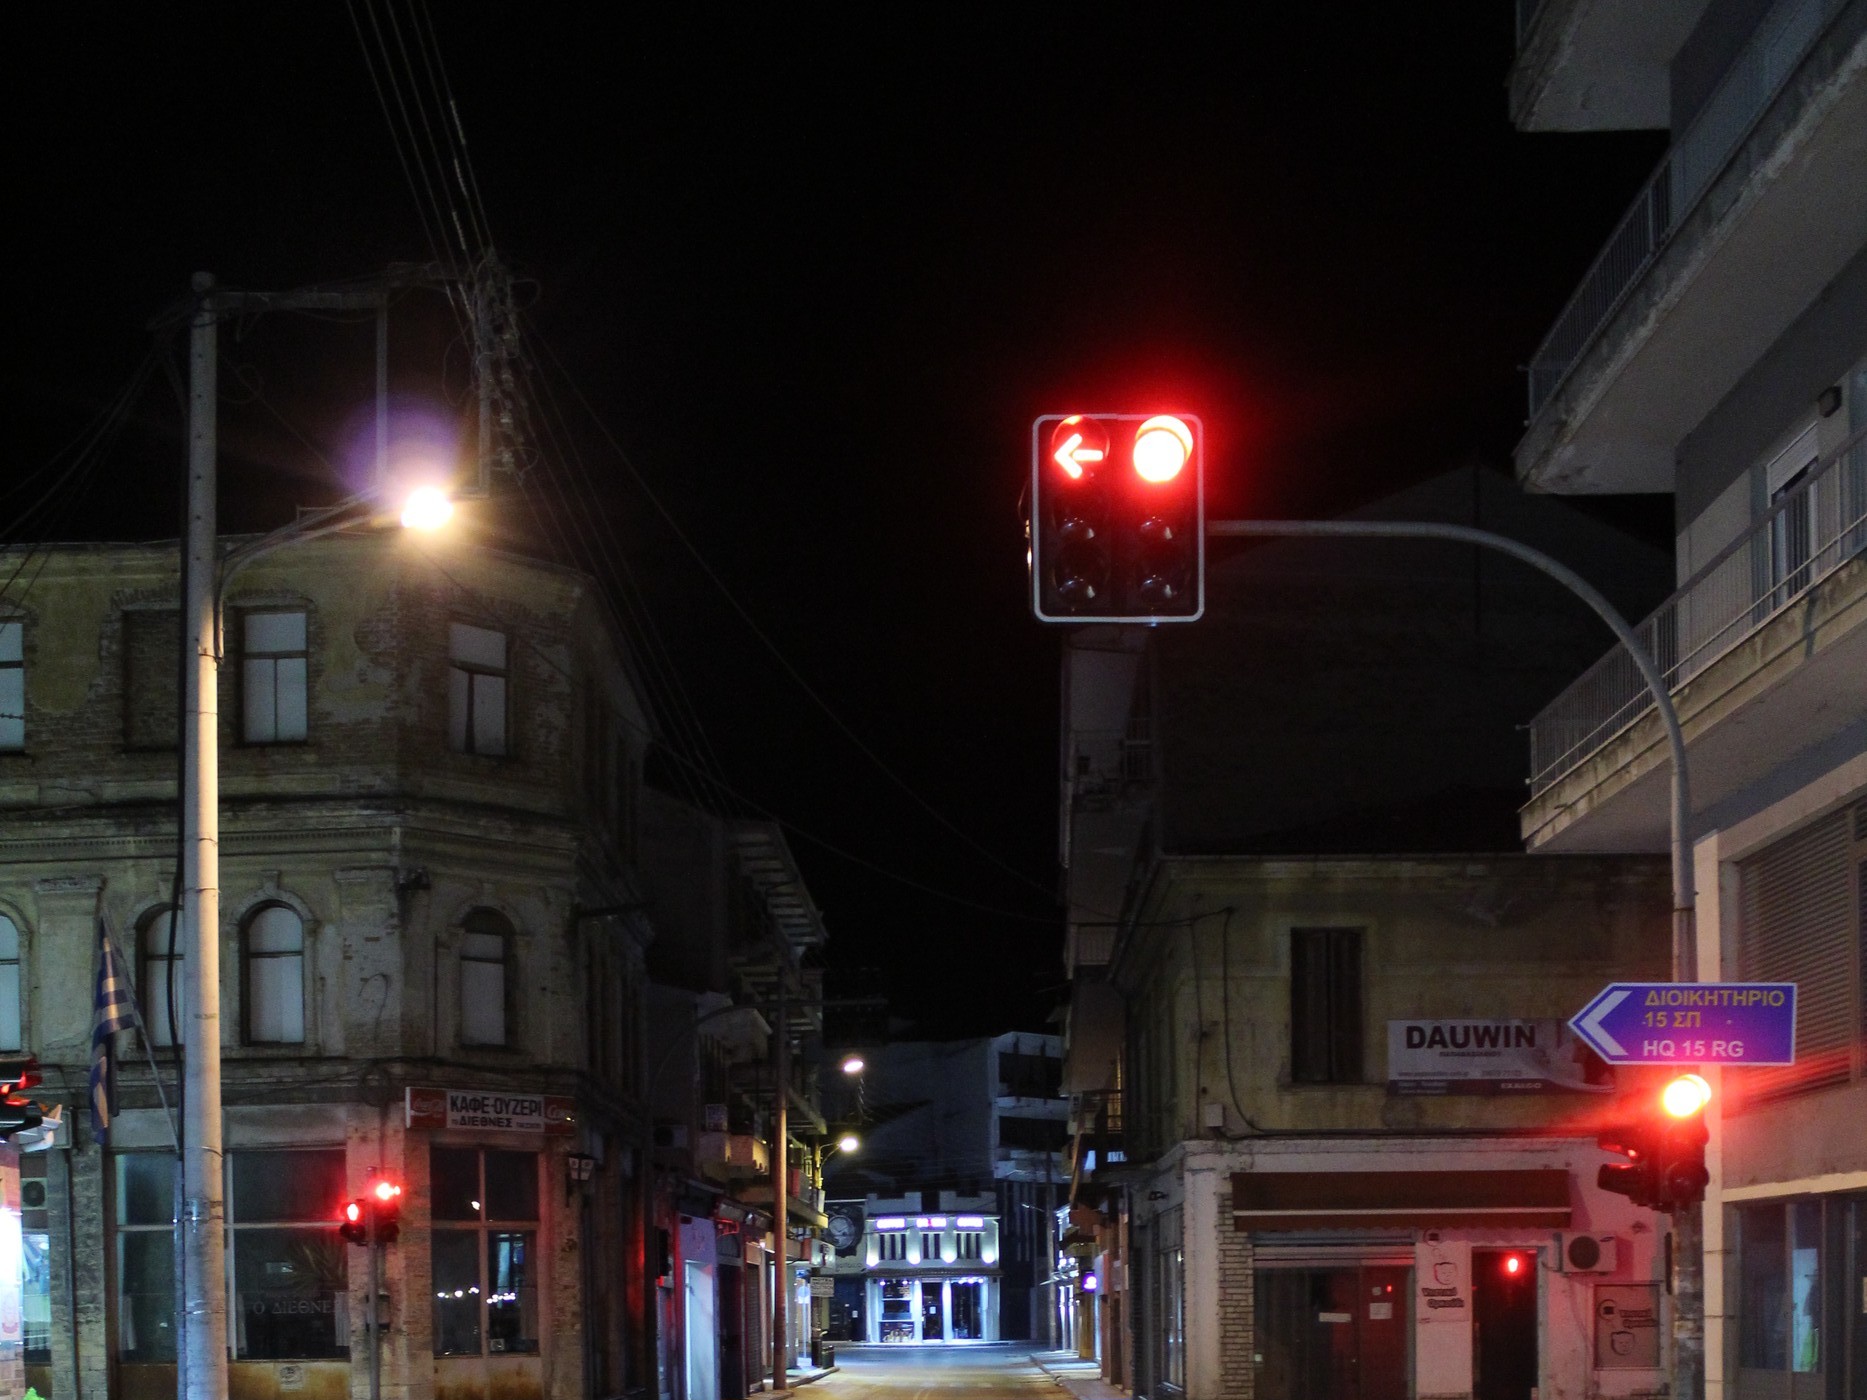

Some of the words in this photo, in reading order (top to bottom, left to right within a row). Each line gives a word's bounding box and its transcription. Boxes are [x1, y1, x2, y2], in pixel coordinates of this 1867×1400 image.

[1645, 989, 1785, 1007] ΔΙΟΙΚΗΤΗΡΙΟ
[1645, 1011, 1668, 1028] 15
[1673, 1011, 1701, 1028] ΣΠ
[1406, 1025, 1536, 1049] DAUWIN
[1643, 1040, 1675, 1057] HQ
[1682, 1040, 1706, 1057] 15
[1712, 1040, 1744, 1058] RG
[459, 1115, 513, 1128] ΔΙΕΘΝΕΣ
[252, 1301, 265, 1314] Ο
[271, 1300, 336, 1314] ΔΙΕΘΝΕ
